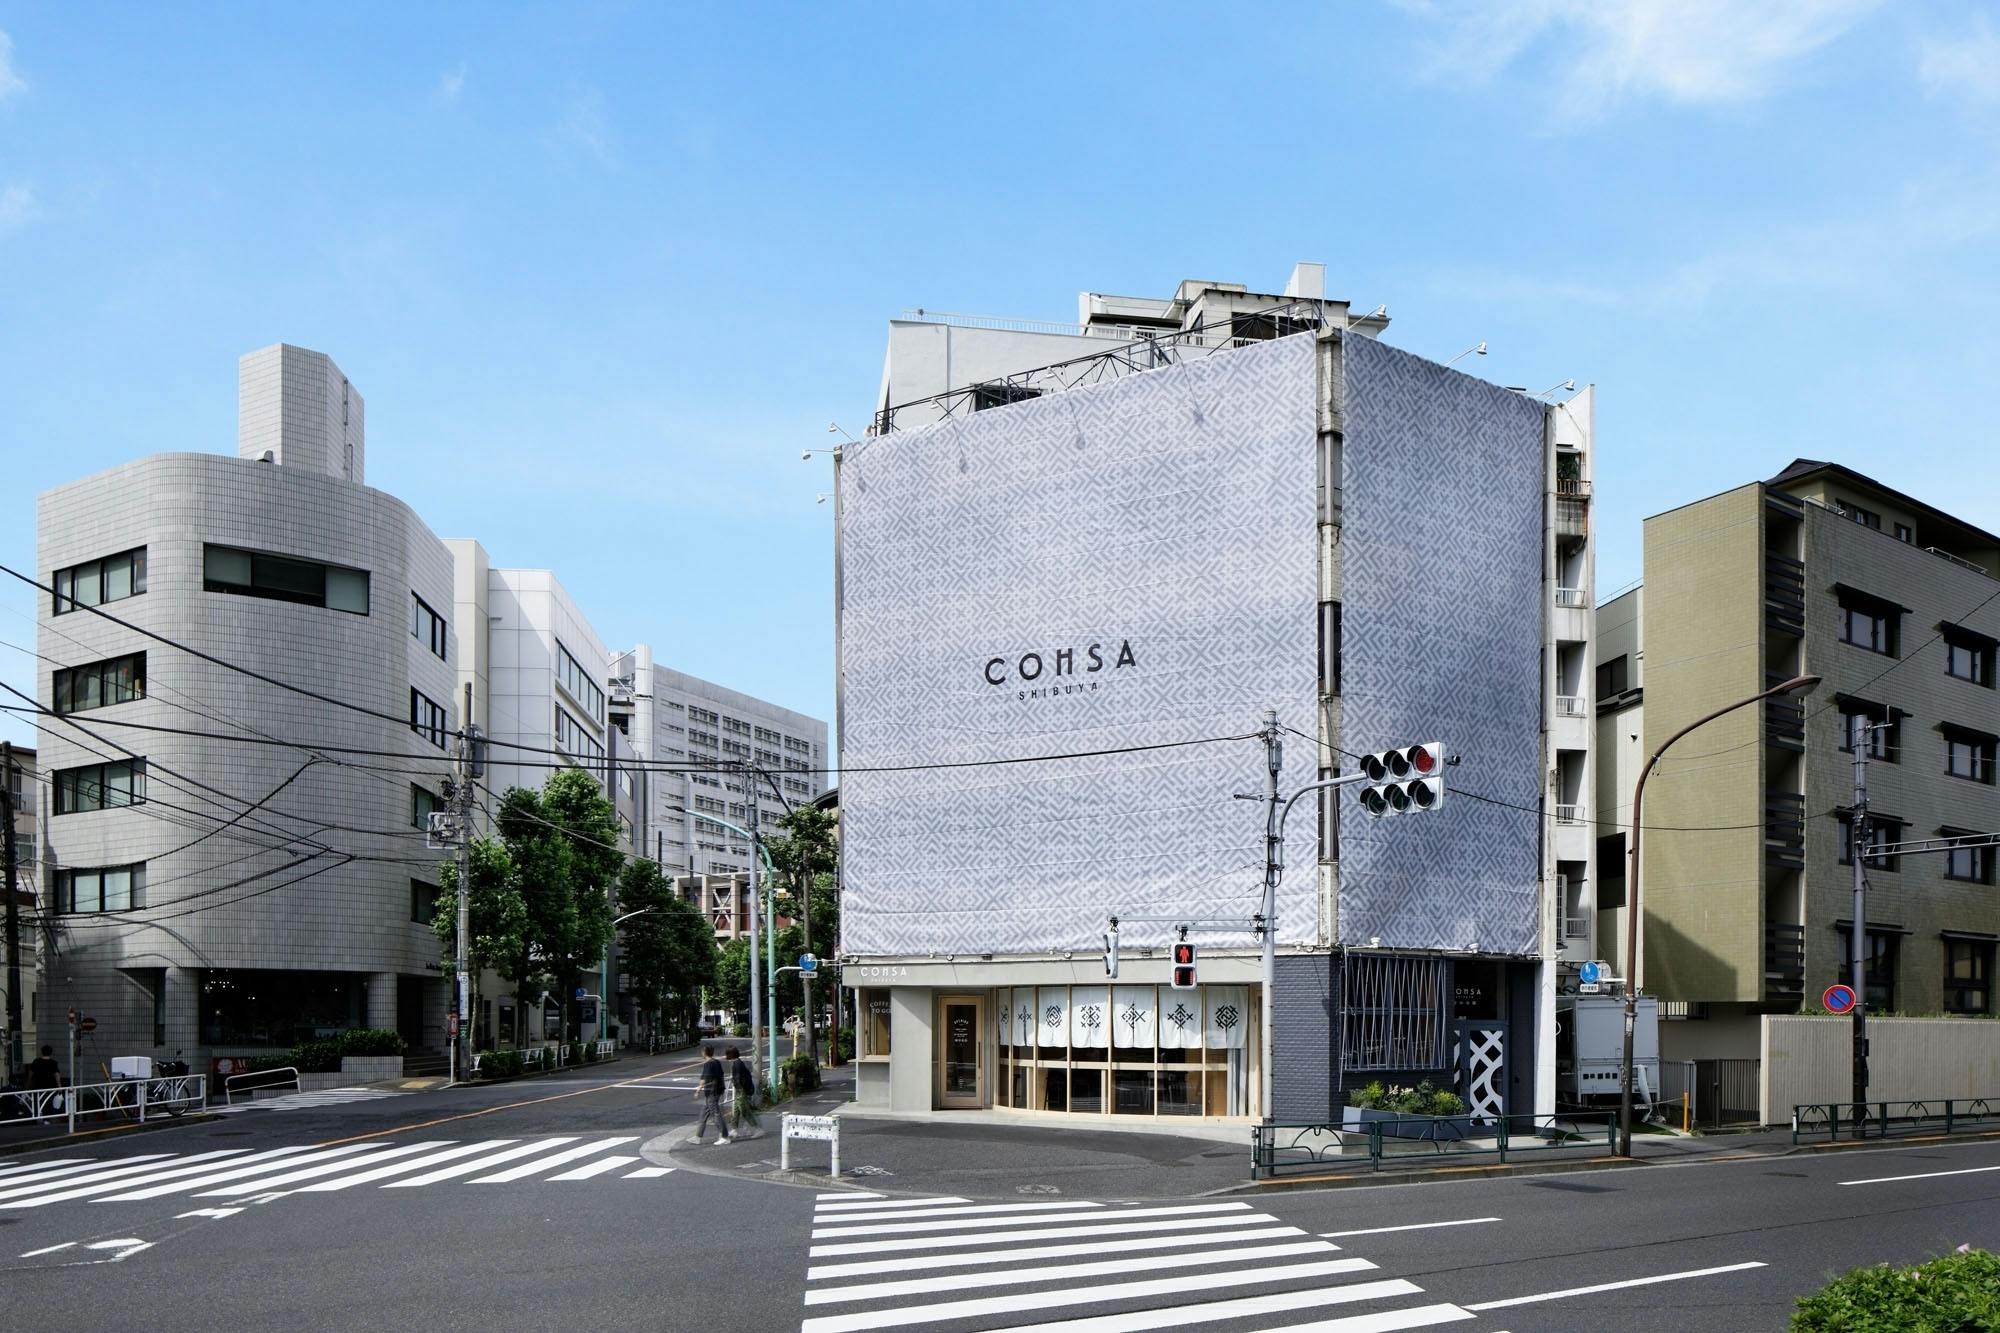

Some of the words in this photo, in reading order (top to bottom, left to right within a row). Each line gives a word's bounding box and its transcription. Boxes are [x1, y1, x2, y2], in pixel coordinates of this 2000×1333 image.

[985, 639, 1136, 685] COHSA
[1019, 682, 1098, 700] SHIBUYA
[583, 1008, 594, 1020] P
